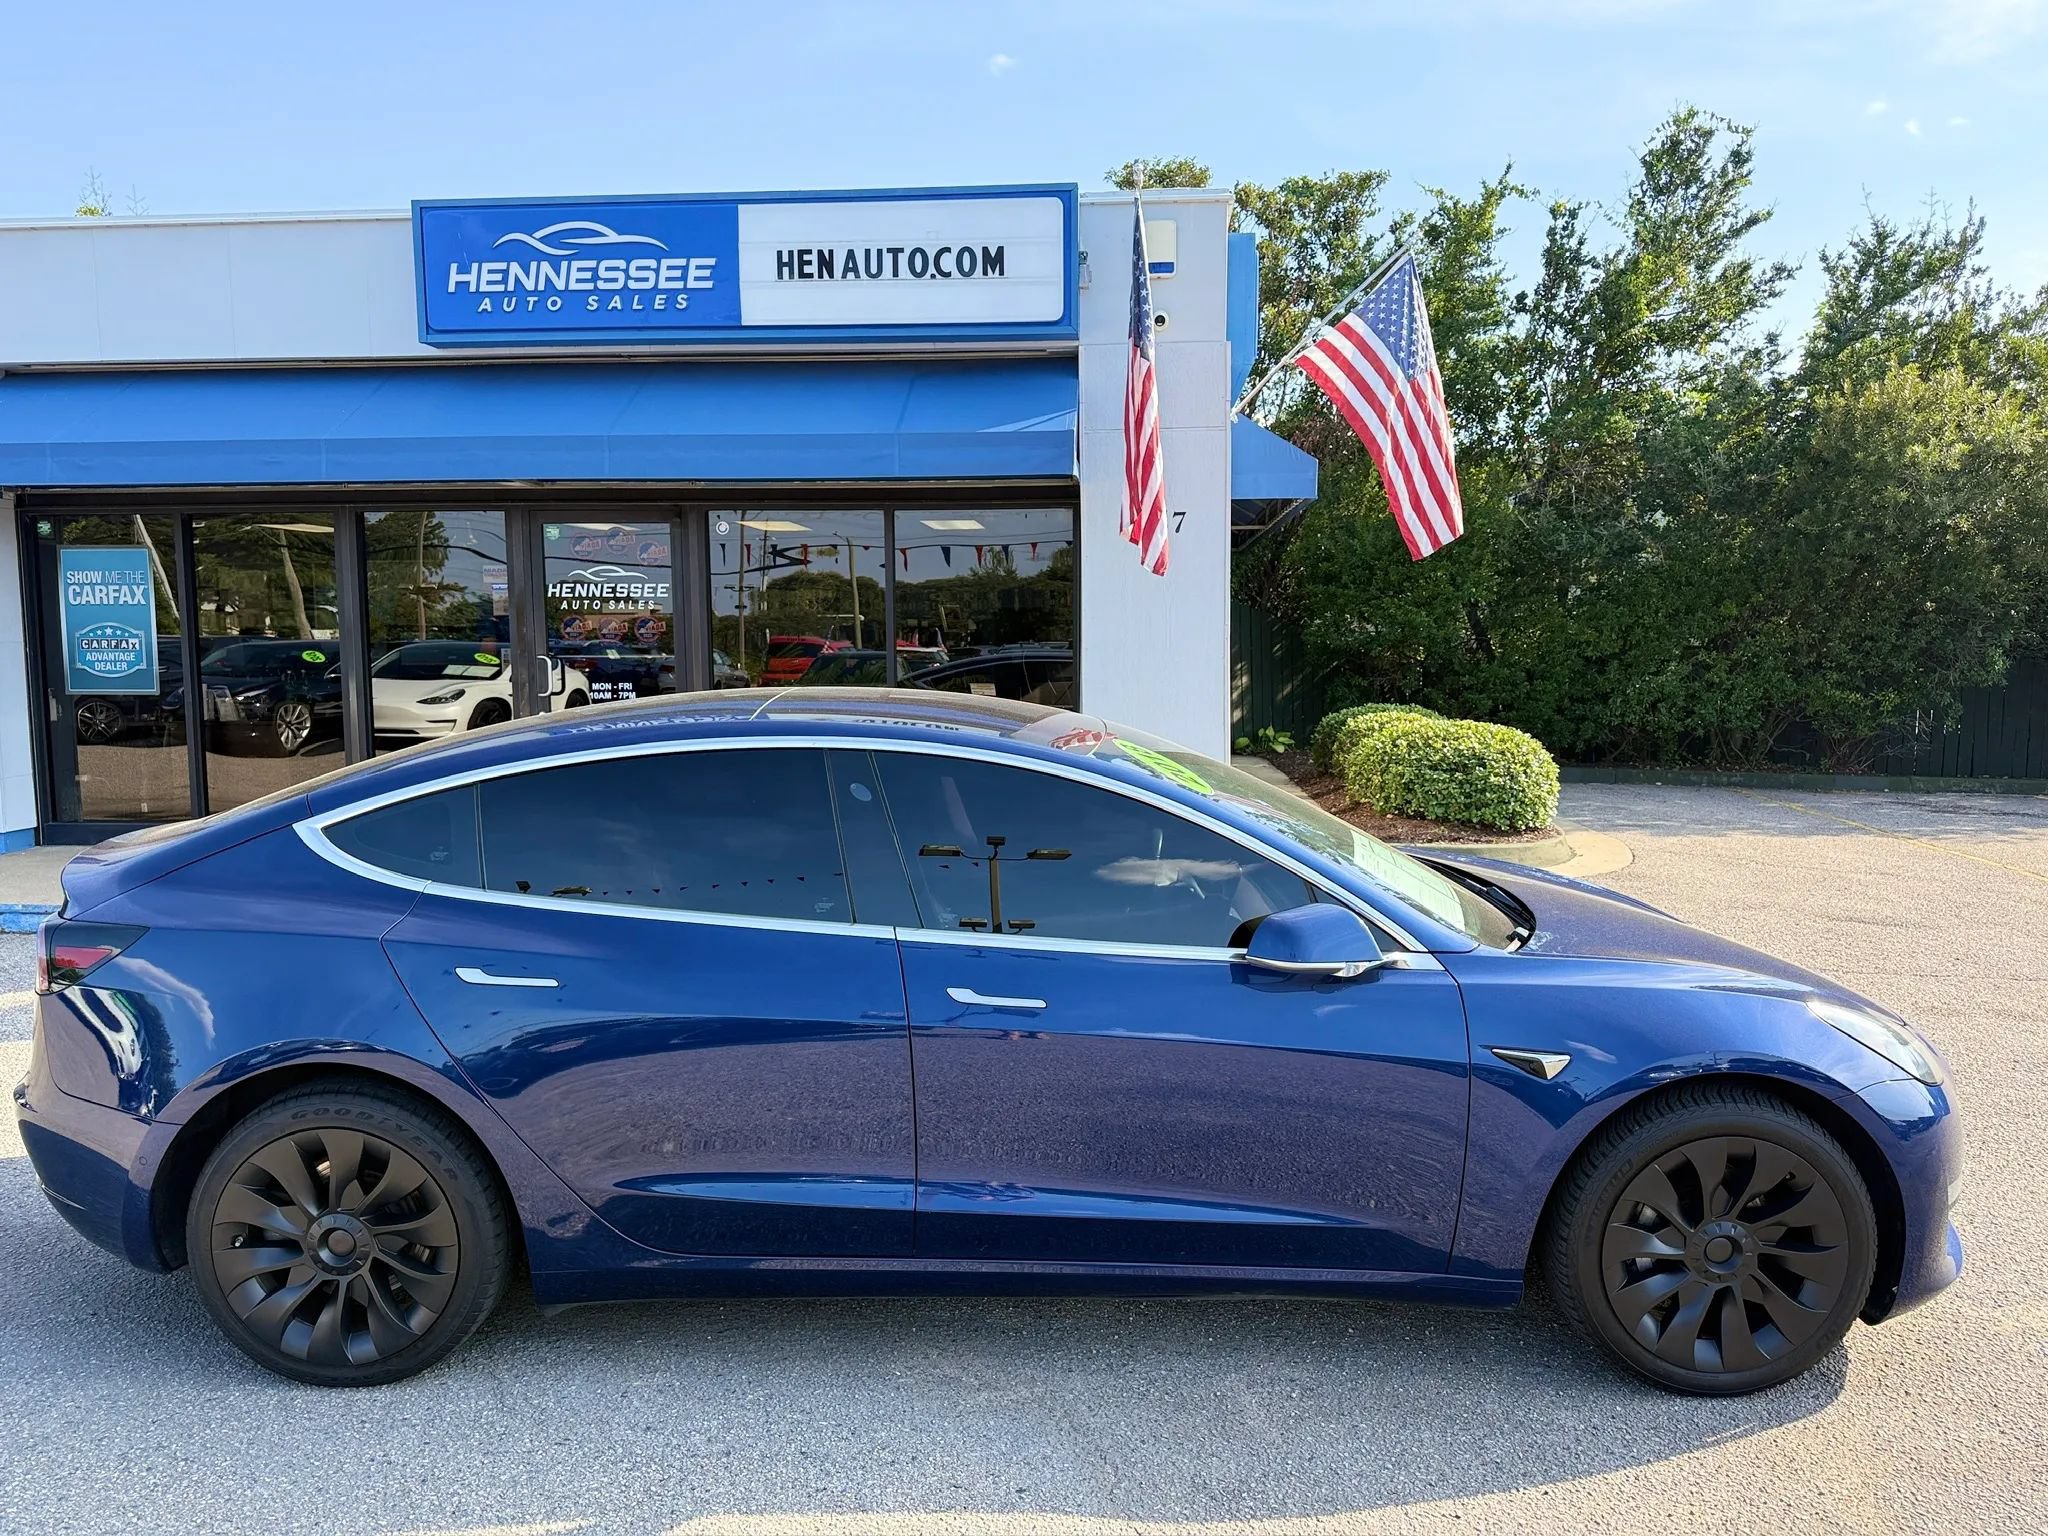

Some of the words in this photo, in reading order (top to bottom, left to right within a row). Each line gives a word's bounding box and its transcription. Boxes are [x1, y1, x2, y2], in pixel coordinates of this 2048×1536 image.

[447, 257, 717, 293] HENNESSEE
[477, 296, 563, 312] AUTO
[586, 294, 690, 311] SALES
[1172, 511, 1187, 533] 7
[66, 571, 102, 584] SHOW
[105, 571, 121, 583] ME
[123, 571, 145, 583] THE
[68, 585, 146, 605] CARFAX
[547, 583, 670, 597] HENNESSEE
[560, 600, 601, 610] AUTO
[608, 600, 655, 610] SALES
[81, 639, 138, 650] CARFAX
[86, 652, 136, 661] ADVANTAGE
[95, 662, 128, 671] DEALER
